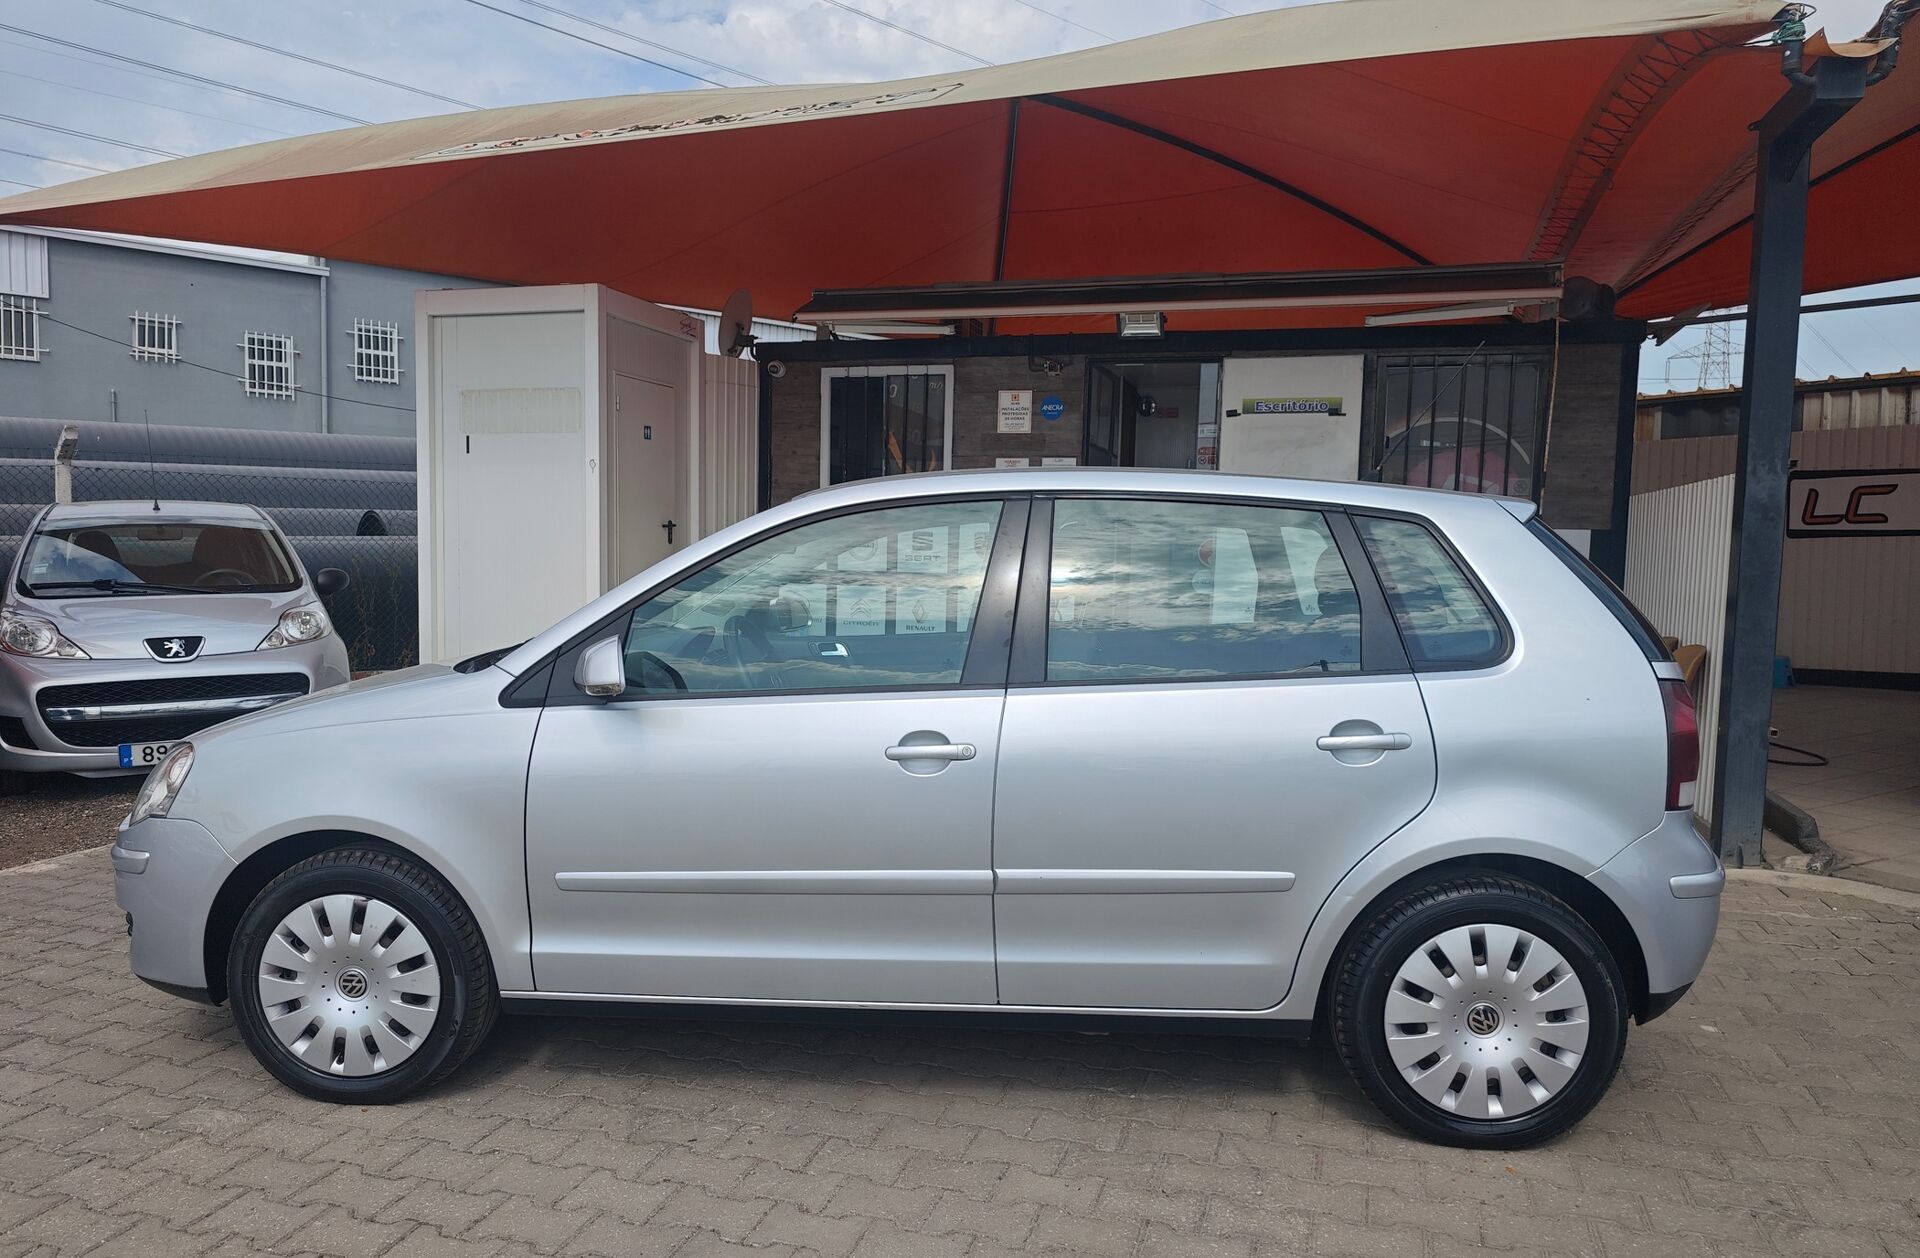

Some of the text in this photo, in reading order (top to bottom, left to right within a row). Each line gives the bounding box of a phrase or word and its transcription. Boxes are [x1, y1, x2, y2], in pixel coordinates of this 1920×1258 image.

[1255, 399, 1329, 412] Escritório
[1801, 483, 1899, 526] LC
[905, 554, 941, 562] SEAT
[905, 624, 936, 632] RENAULT
